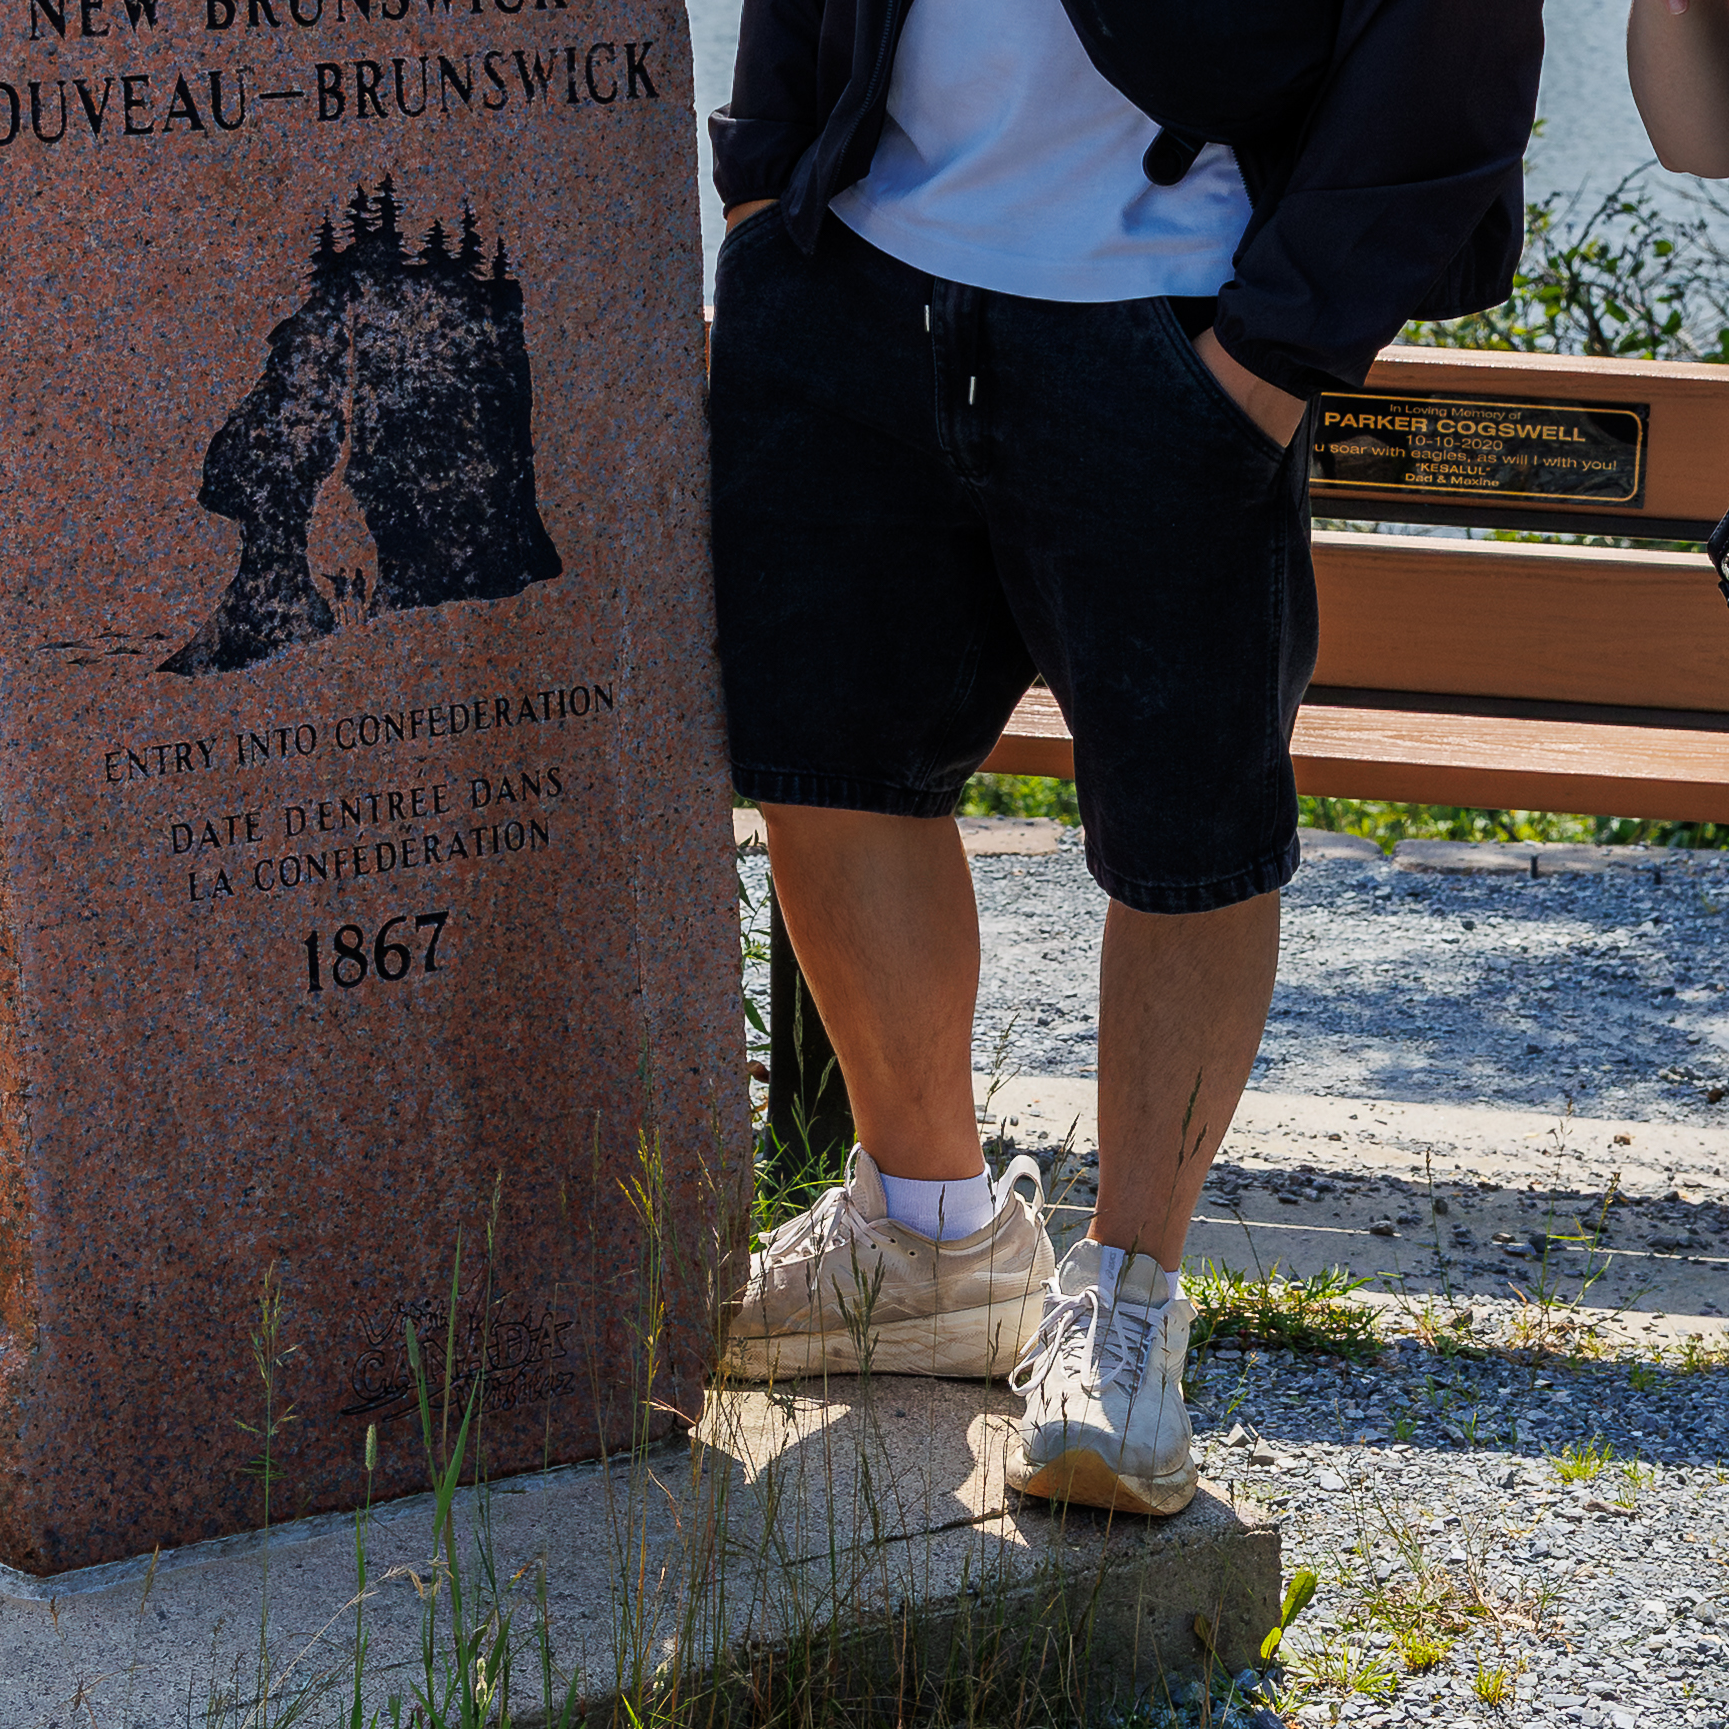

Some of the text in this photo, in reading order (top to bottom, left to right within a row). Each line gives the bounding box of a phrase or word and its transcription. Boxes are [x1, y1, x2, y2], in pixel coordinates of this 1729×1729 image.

[1324, 411, 1586, 443] PARKER COGSWELL
[1389, 403, 1522, 421] In Loving Memory of
[1330, 443, 1368, 455] soar
[1371, 445, 1406, 458] with
[1410, 449, 1471, 463] eagles,
[1476, 453, 1497, 464] as
[1502, 453, 1528, 466] will
[1542, 456, 1577, 468] with
[1581, 459, 1617, 471] you!
[1406, 434, 1503, 451] 10-10-2020
[1405, 472, 1500, 487] Dad & Maxine
[104, 682, 615, 784] ENTRY INTO CONFEDERATION
[171, 811, 264, 855] DATE
[470, 766, 564, 811] DANS
[188, 868, 235, 902] LA
[303, 911, 450, 994] 1867
[351, 1310, 574, 1403] CANADA
